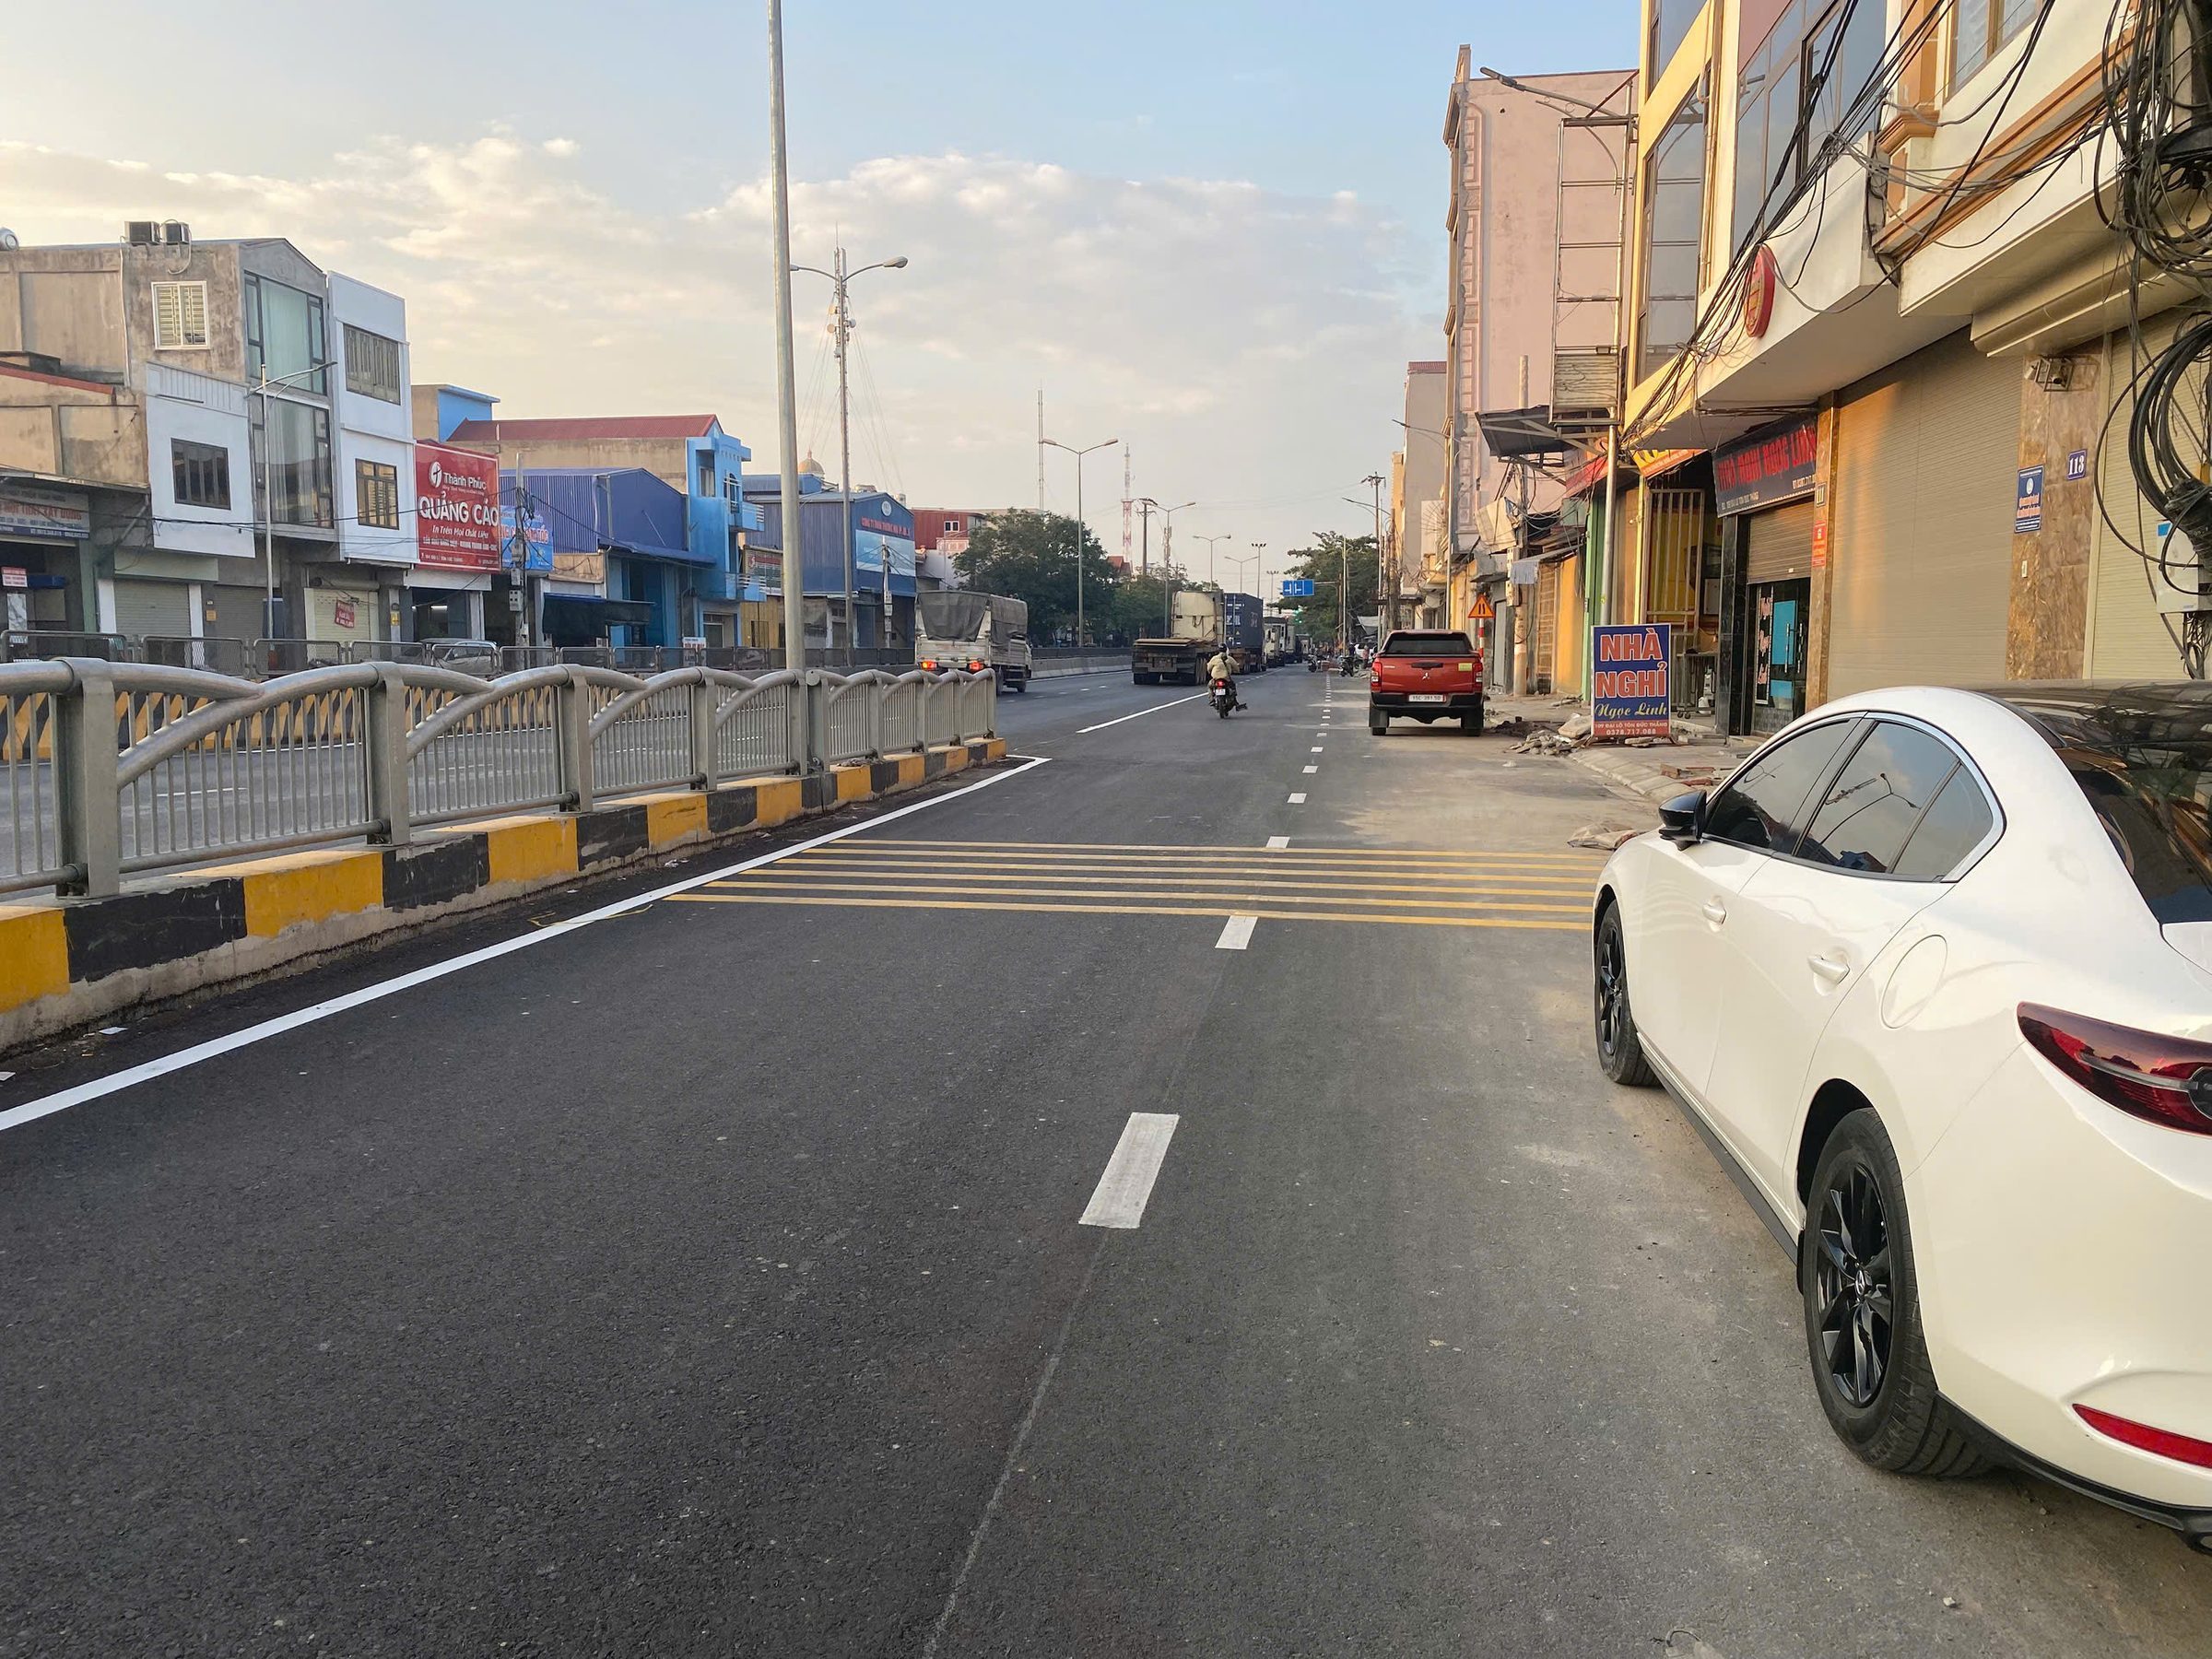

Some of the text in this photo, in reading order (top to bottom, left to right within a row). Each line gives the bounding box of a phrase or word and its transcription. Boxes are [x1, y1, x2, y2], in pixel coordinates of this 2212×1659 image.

[2069, 454, 2085, 476] 113
[443, 471, 487, 490] Thành Phúc
[419, 491, 499, 526] QUẢNG CÁO
[1600, 628, 1663, 662] NHÀ
[1595, 661, 1667, 699] NGHỈ
[1594, 702, 1667, 719] Ngọc Linh
